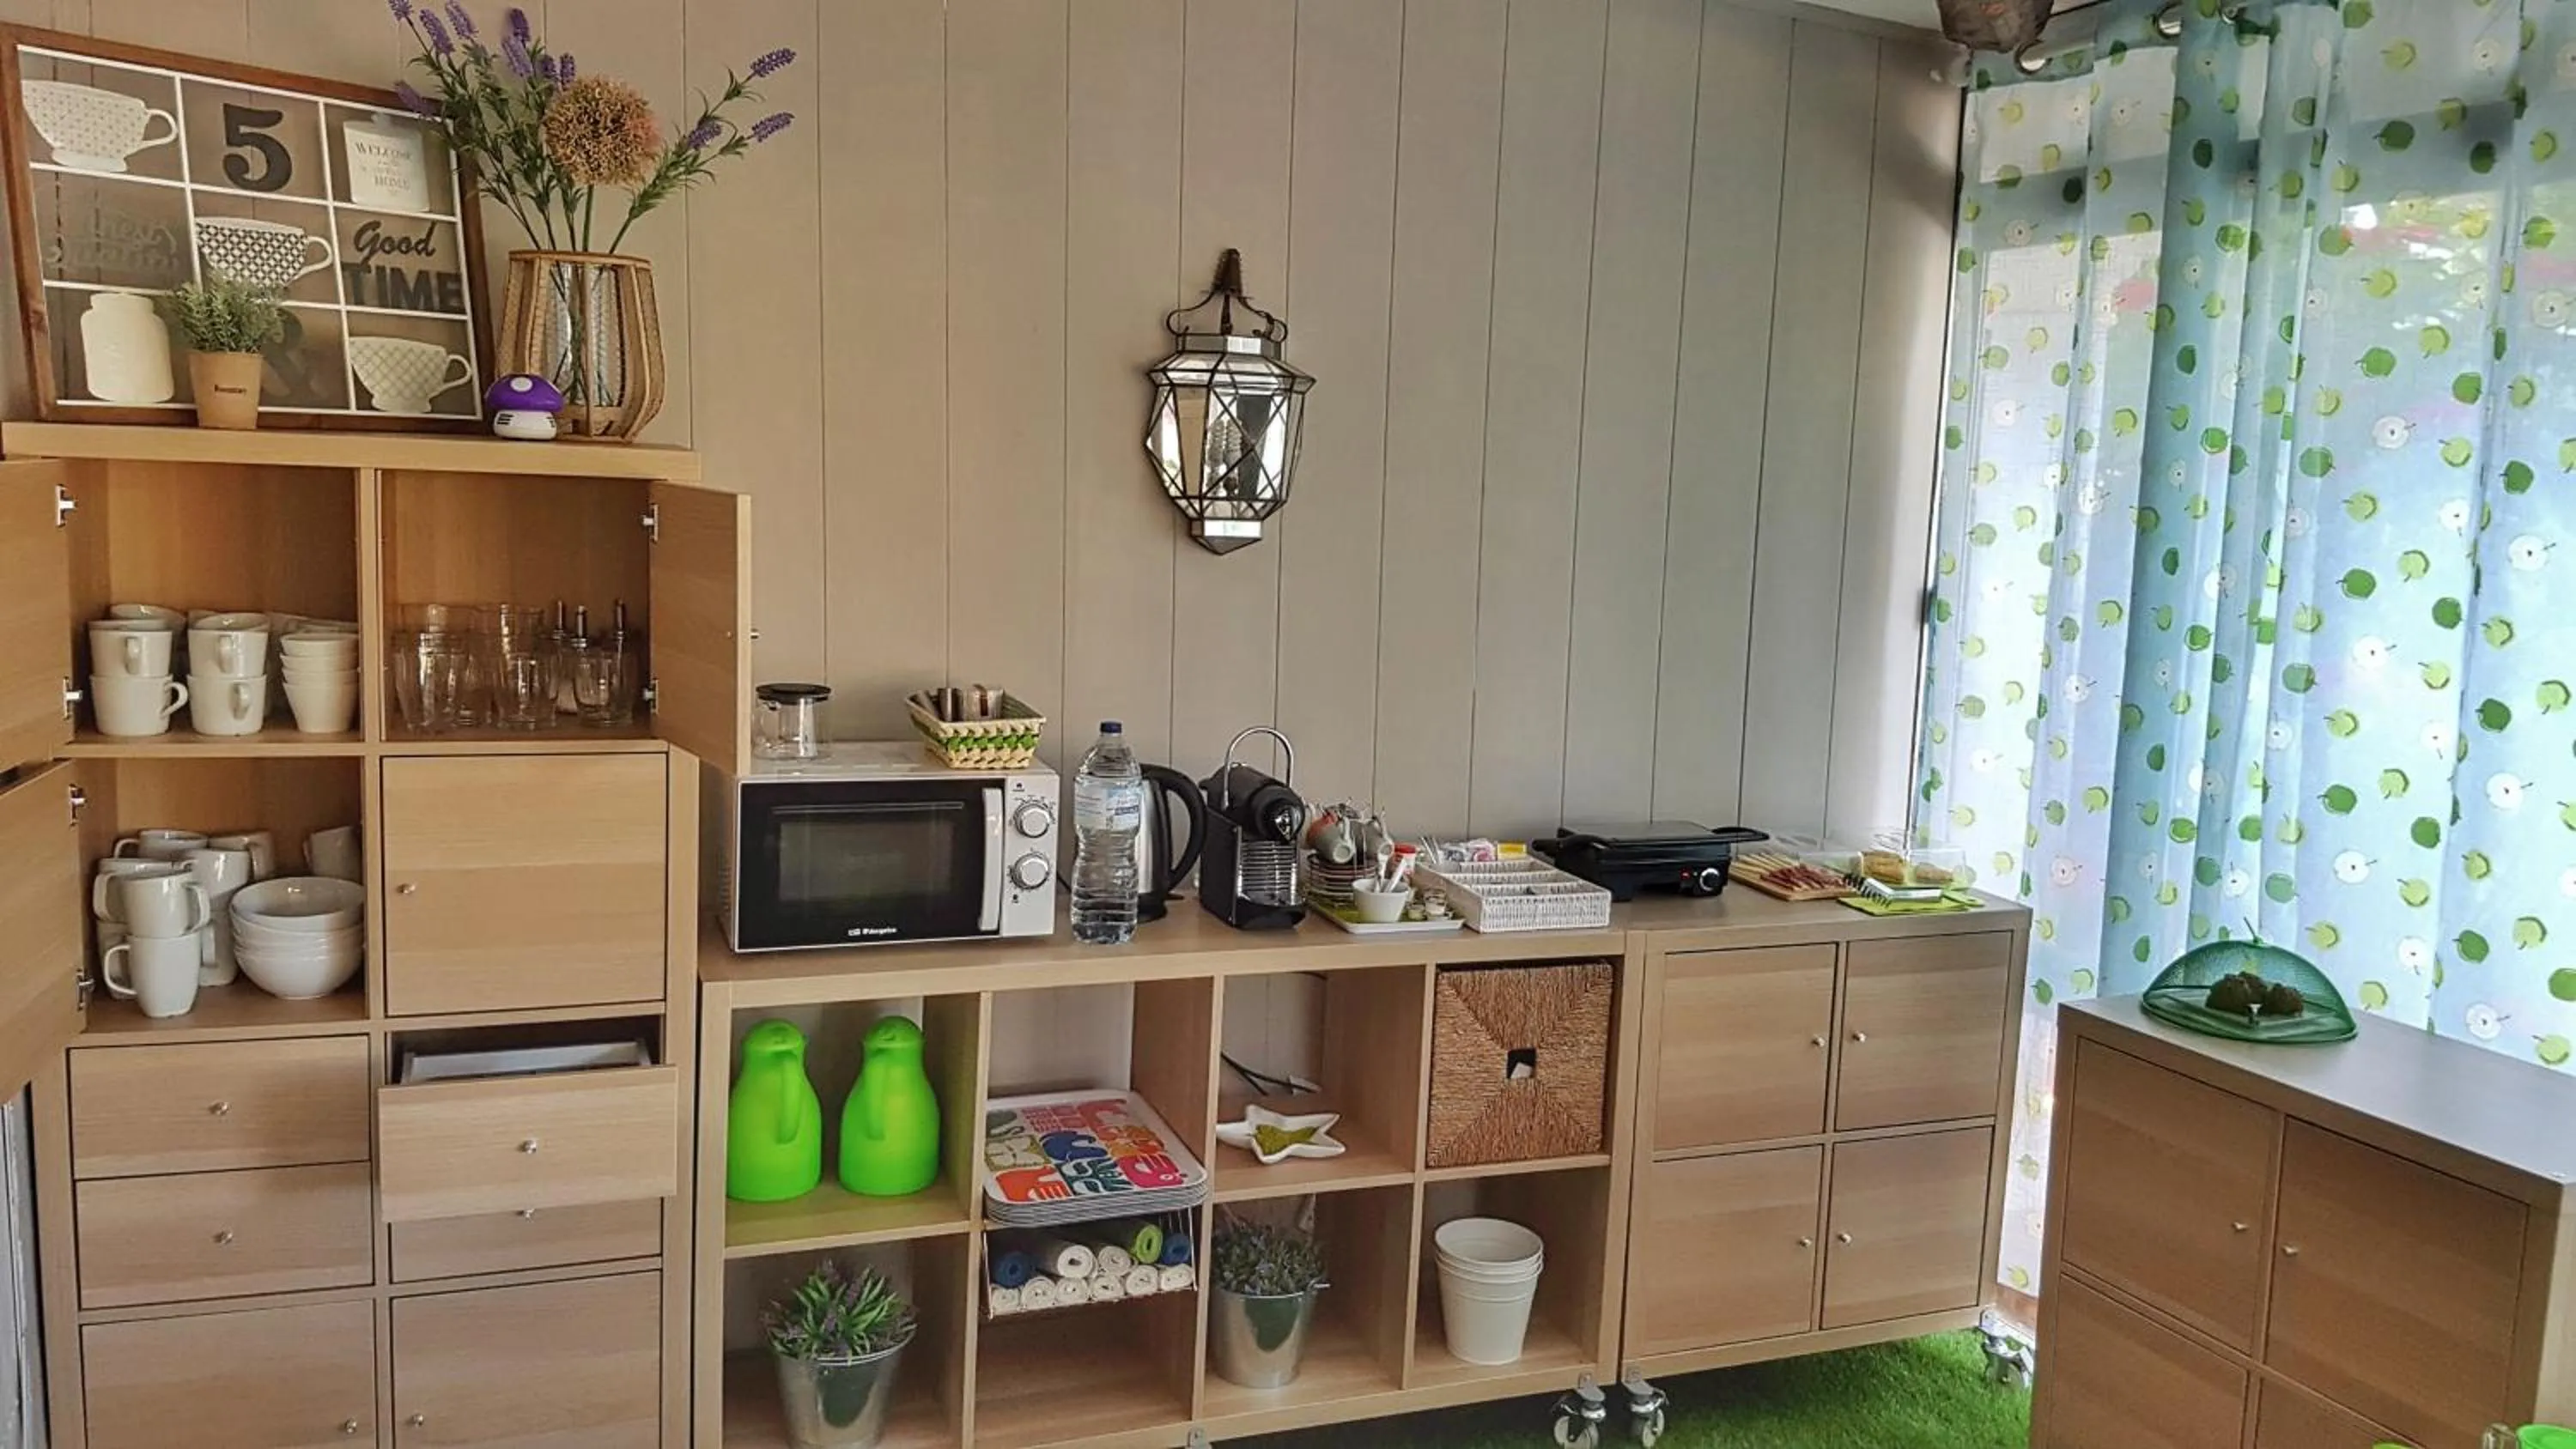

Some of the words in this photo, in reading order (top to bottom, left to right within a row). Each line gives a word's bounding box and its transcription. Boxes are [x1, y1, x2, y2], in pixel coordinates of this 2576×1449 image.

[222, 102, 293, 193] 5
[353, 219, 437, 267] Good
[341, 260, 468, 315] TIME
